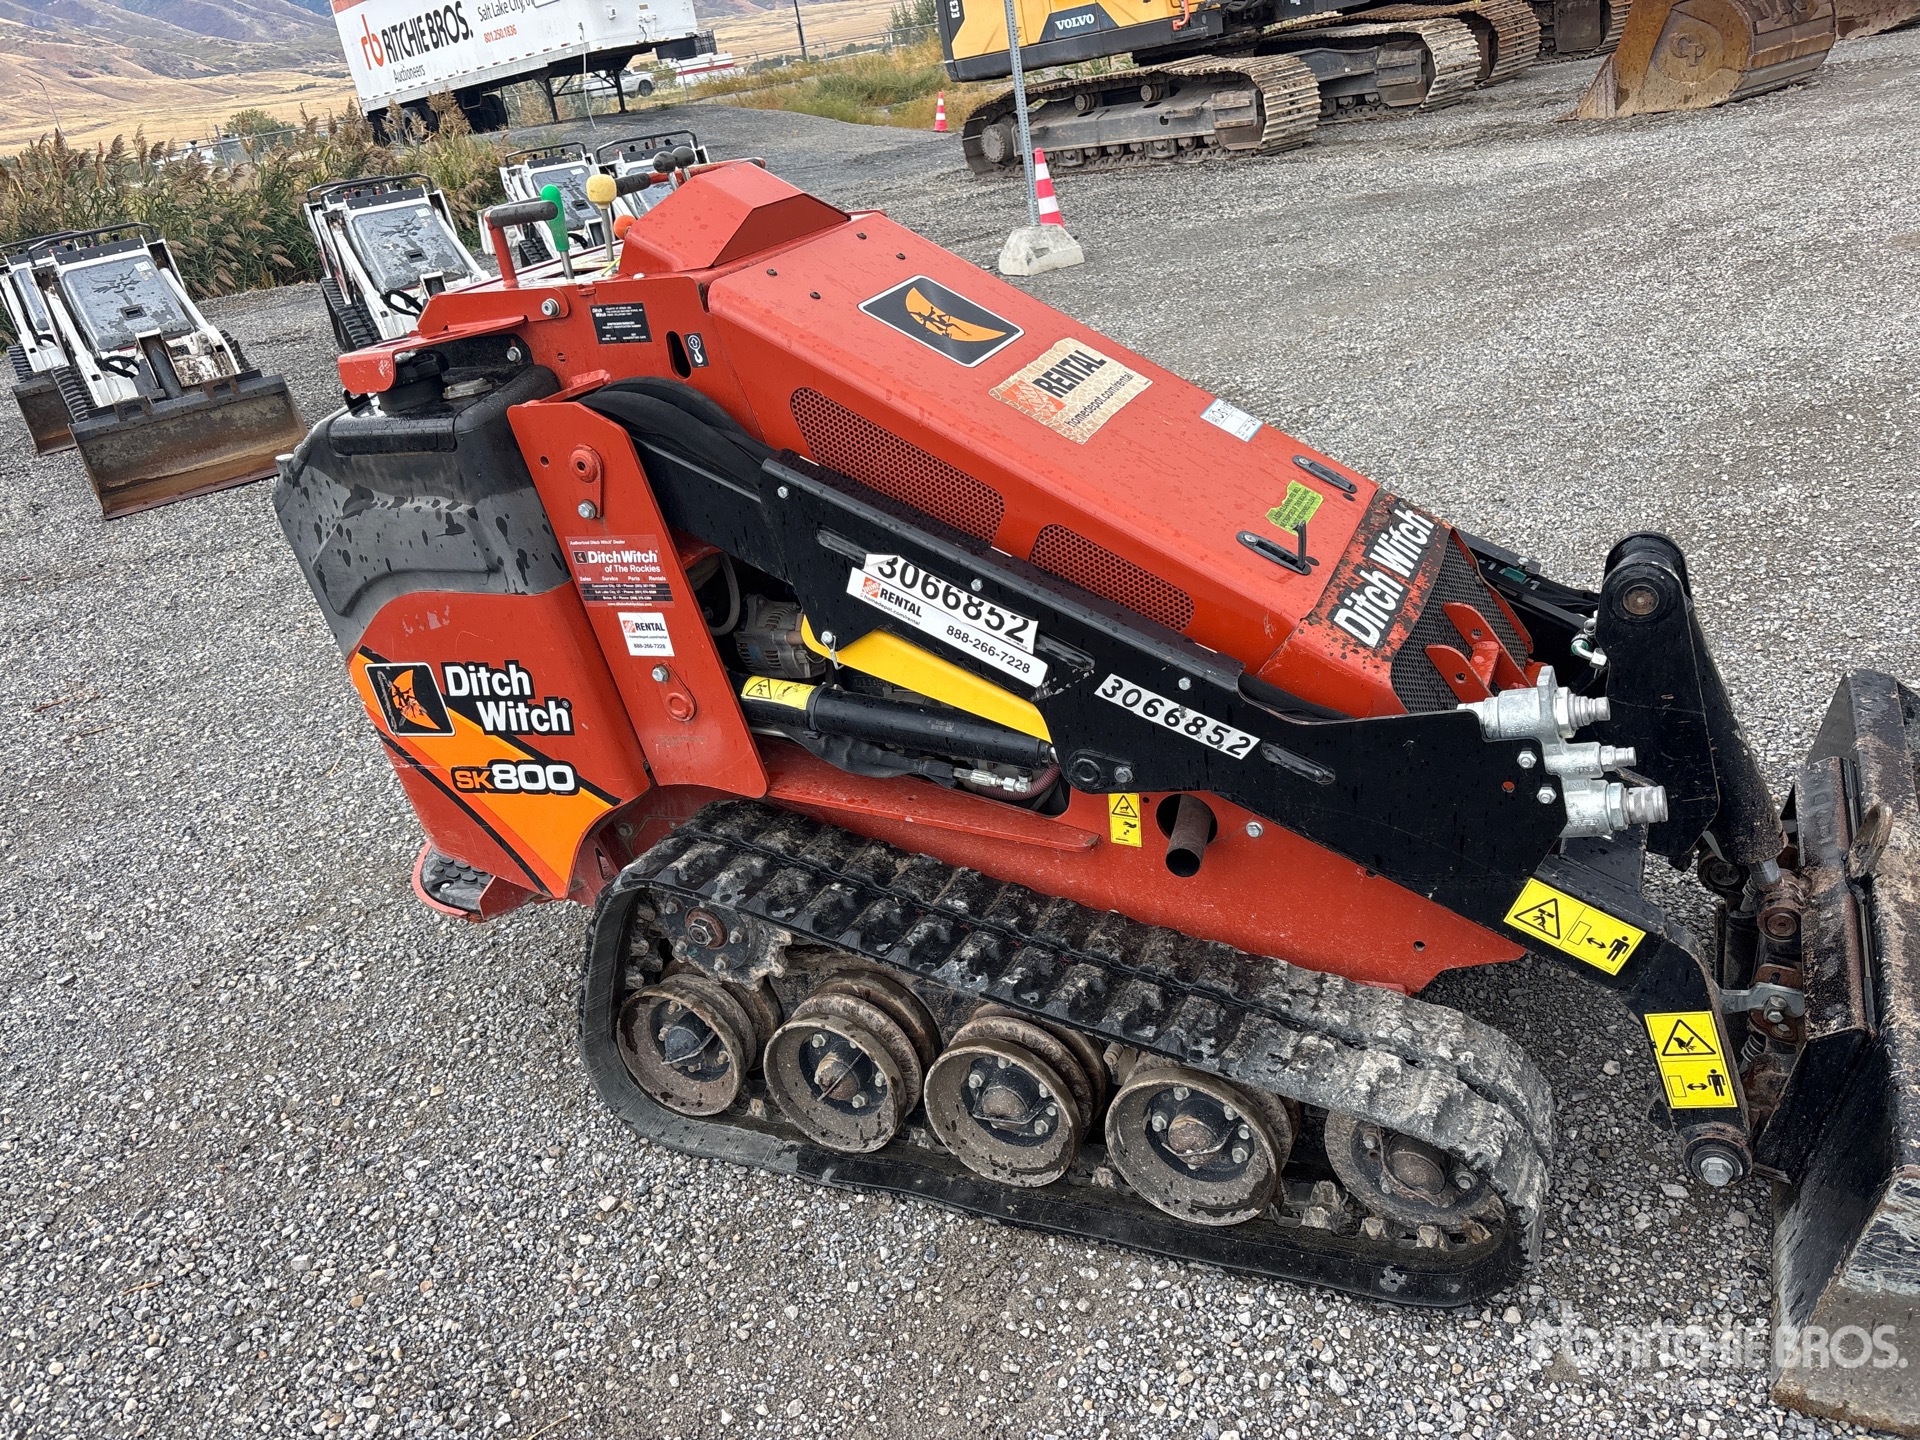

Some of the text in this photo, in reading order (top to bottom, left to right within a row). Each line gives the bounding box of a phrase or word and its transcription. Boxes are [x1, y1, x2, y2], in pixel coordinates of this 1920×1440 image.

[477, 4, 493, 22] Salt
[491, 0, 509, 17] Lake
[1055, 13, 1095, 31] VOLVO
[381, 15, 431, 64] RITCHIE
[425, 0, 474, 49] BROS.
[484, 24, 518, 43] 801.250.1836
[393, 64, 426, 84] Auctioneers
[1032, 350, 1107, 399] RENTAL
[1065, 371, 1134, 428] homedepot.com/rental
[587, 550, 621, 563] Ditch
[604, 565, 661, 573] of The Rockies
[1334, 508, 1435, 648] Ditch Witch
[877, 555, 1030, 644] 3066852
[880, 588, 922, 618] RENTAL
[635, 622, 666, 631] RENTAL
[946, 625, 1031, 674] 888-266-7228
[444, 661, 532, 697] Ditch
[477, 700, 571, 732] Witch
[1101, 678, 1252, 756] 3066852
[454, 763, 576, 792] SK800
